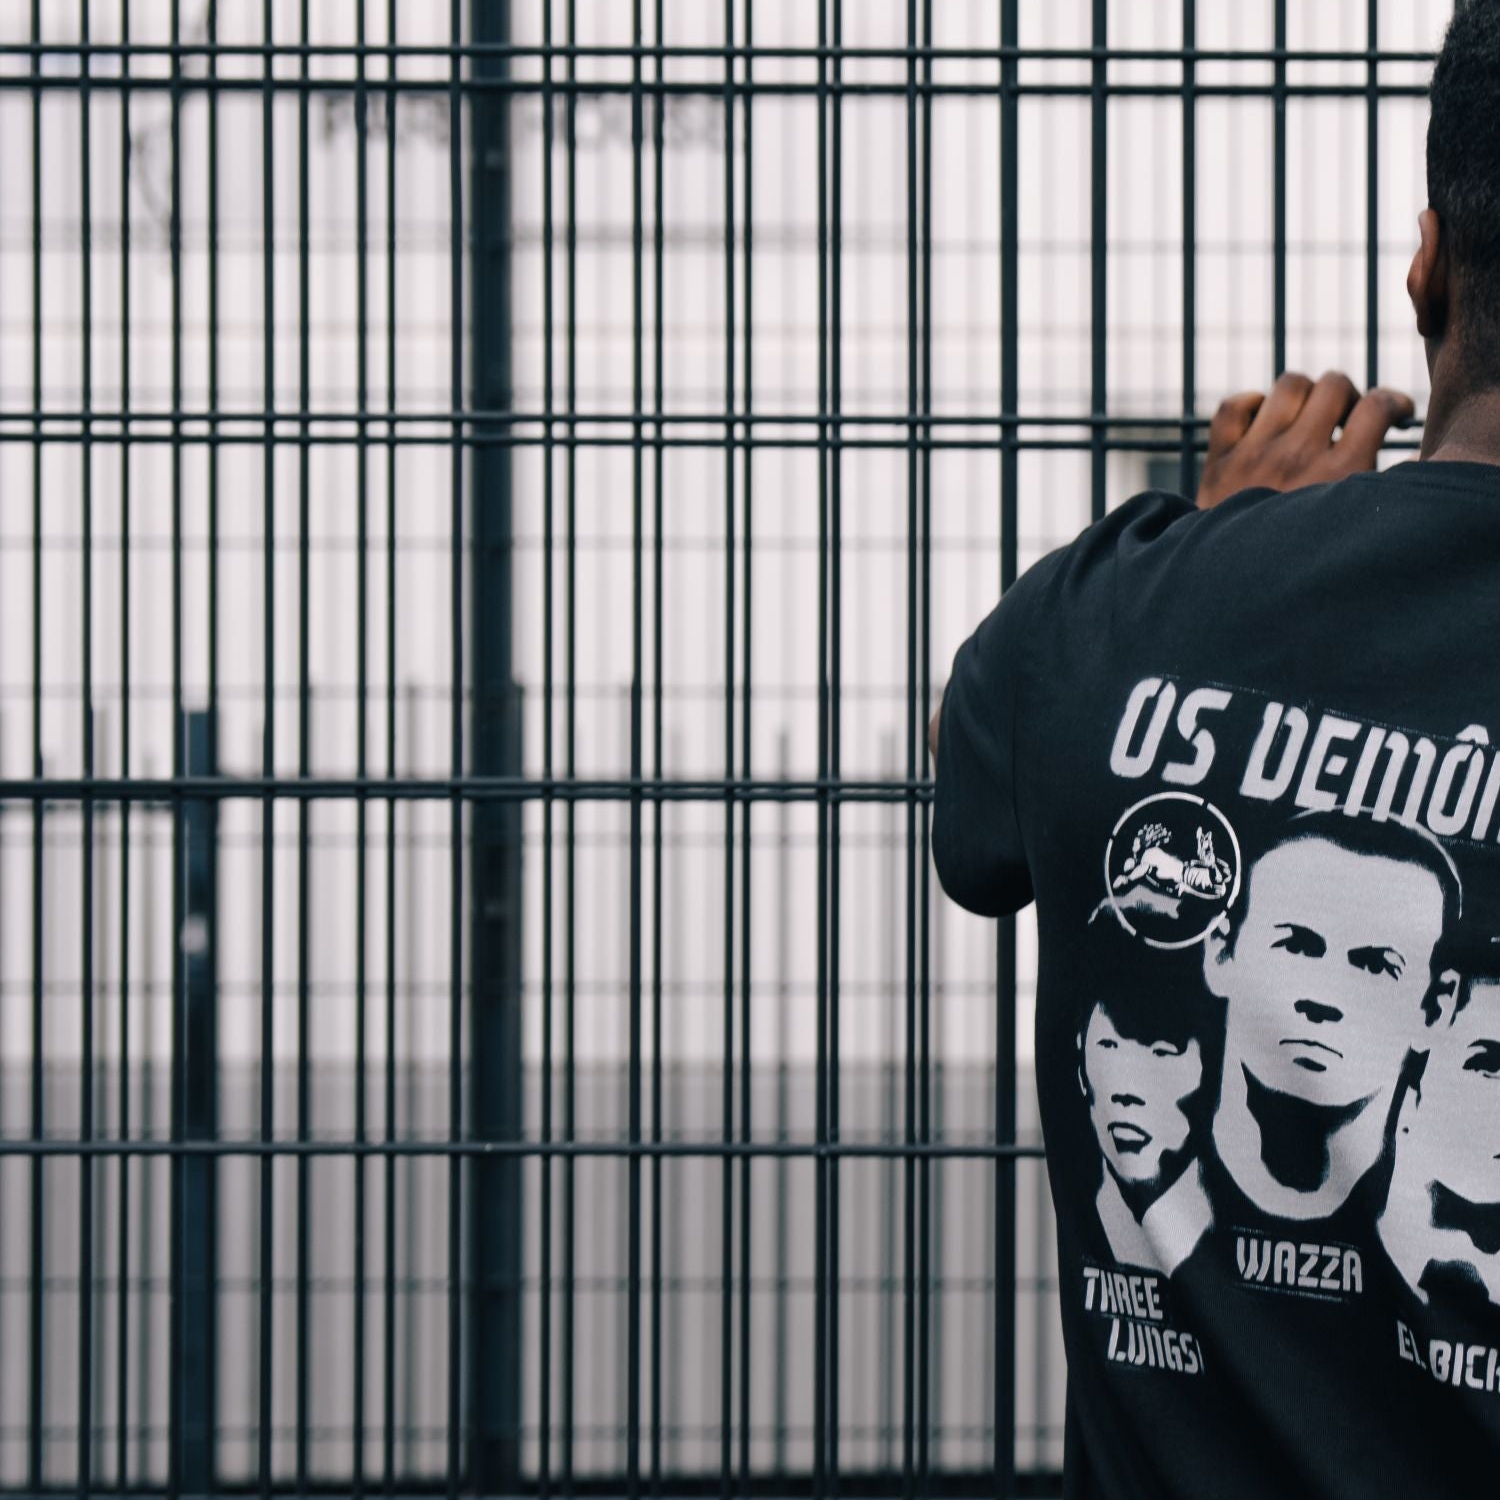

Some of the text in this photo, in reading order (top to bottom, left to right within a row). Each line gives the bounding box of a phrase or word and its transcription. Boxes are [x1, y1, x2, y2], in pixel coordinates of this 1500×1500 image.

[1109, 676, 1233, 787] OS
[1236, 1235, 1363, 1294] WAZZA
[1082, 1266, 1164, 1321] THREE
[1397, 1319, 1427, 1371] EL
